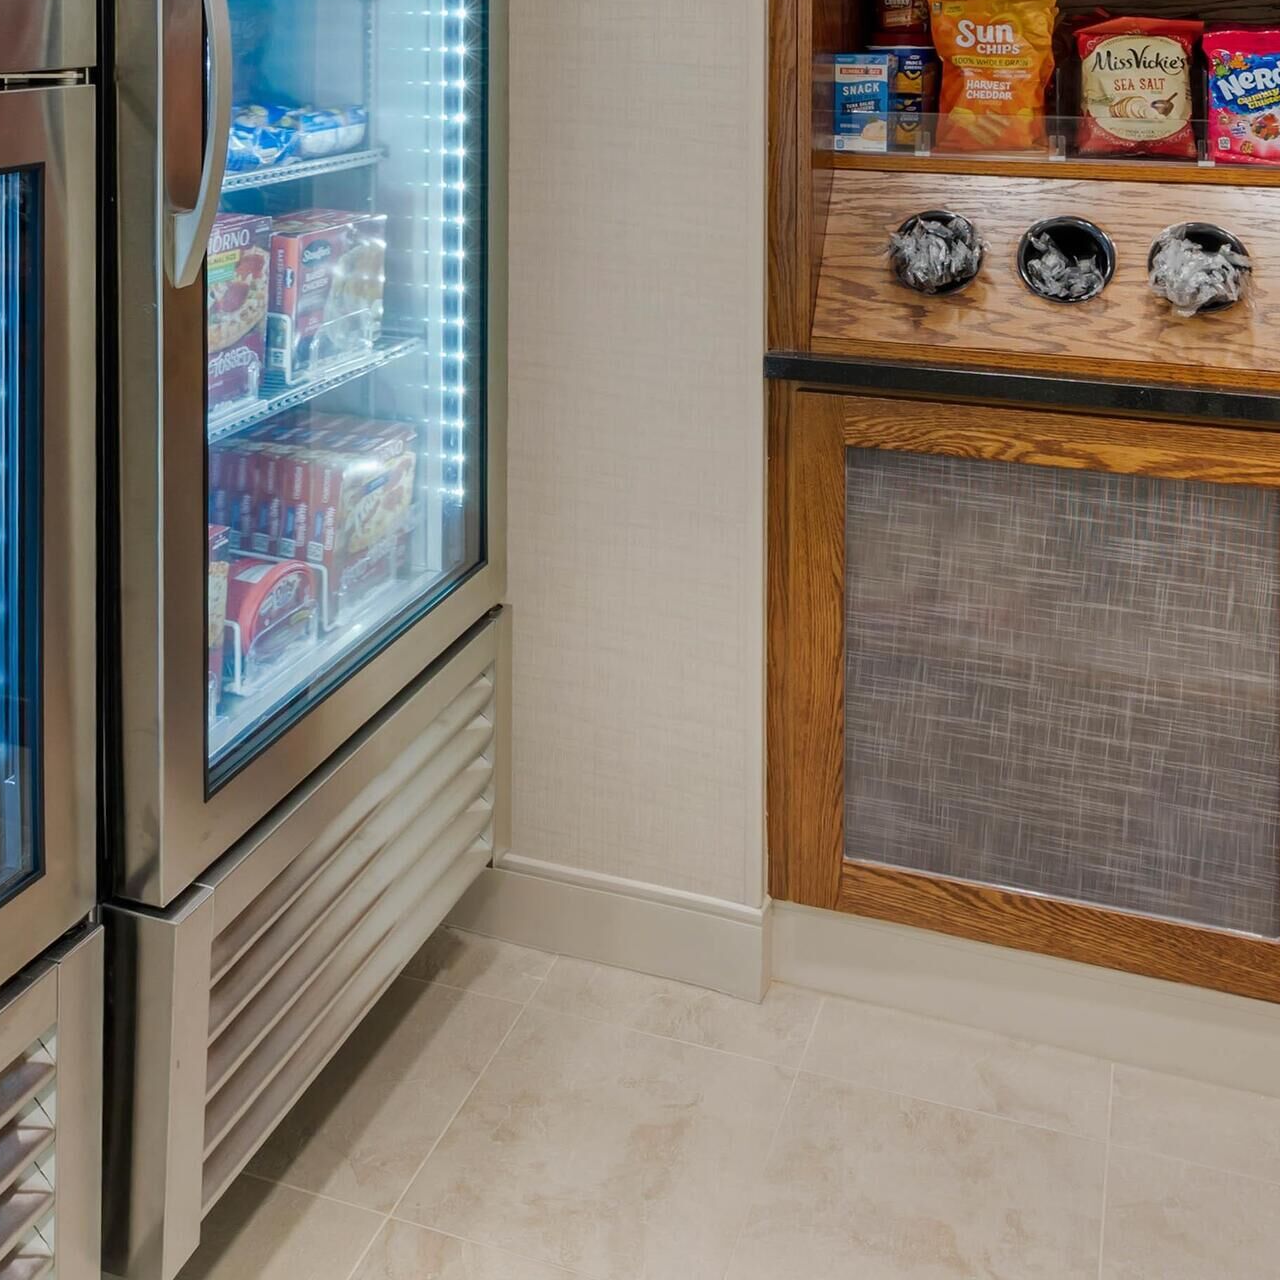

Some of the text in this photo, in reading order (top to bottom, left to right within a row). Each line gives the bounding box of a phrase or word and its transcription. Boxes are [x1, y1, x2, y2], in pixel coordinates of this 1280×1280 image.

[954, 19, 1015, 48] Sun
[976, 42, 1021, 55] CHIPS
[954, 57, 1030, 67] 100% WHOLE GRAIN
[1091, 44, 1189, 75] Miss Vickie's
[841, 82, 880, 97] SNACK
[966, 79, 1012, 91] HARVEST
[1113, 77, 1167, 92] SEA SALT
[966, 89, 1013, 101] CHEDDAR
